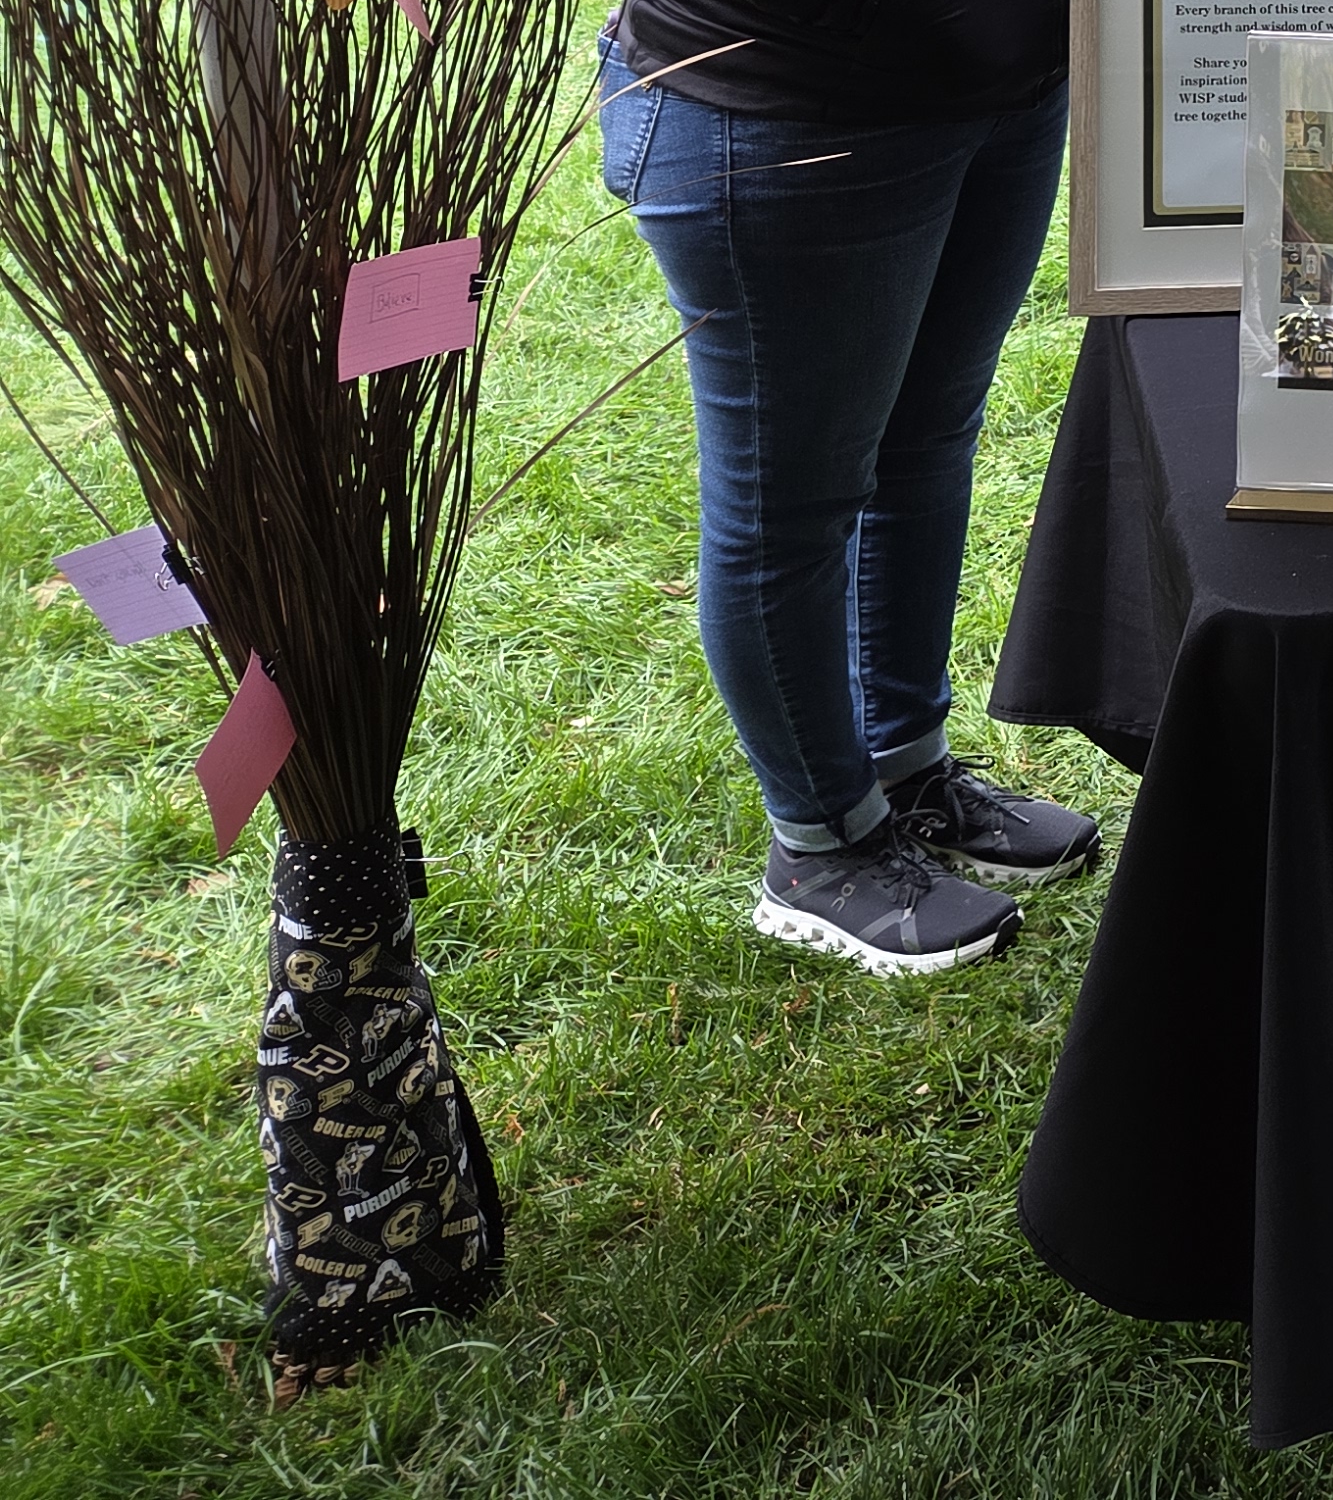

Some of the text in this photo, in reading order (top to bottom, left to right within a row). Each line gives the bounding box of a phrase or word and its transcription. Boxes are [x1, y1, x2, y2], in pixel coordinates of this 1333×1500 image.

[1176, 5, 1211, 16] Every
[1214, 4, 1256, 15] branch
[1260, 3, 1274, 14] of
[1275, 3, 1298, 14] this
[1302, 4, 1325, 14] tree
[1180, 22, 1232, 34] strength
[1235, 21, 1258, 32] and
[1260, 21, 1306, 31] wisdom
[1310, 20, 1323, 31] of
[1194, 58, 1247, 71] Share yo
[1179, 92, 1247, 104] WISP stud
[1174, 111, 1247, 122] tree togethe
[367, 1036, 414, 1088] PURDUE
[313, 1117, 386, 1139] BOILER UP
[343, 1175, 411, 1223] PURDUE
[295, 1253, 367, 1278] BOILER UP
